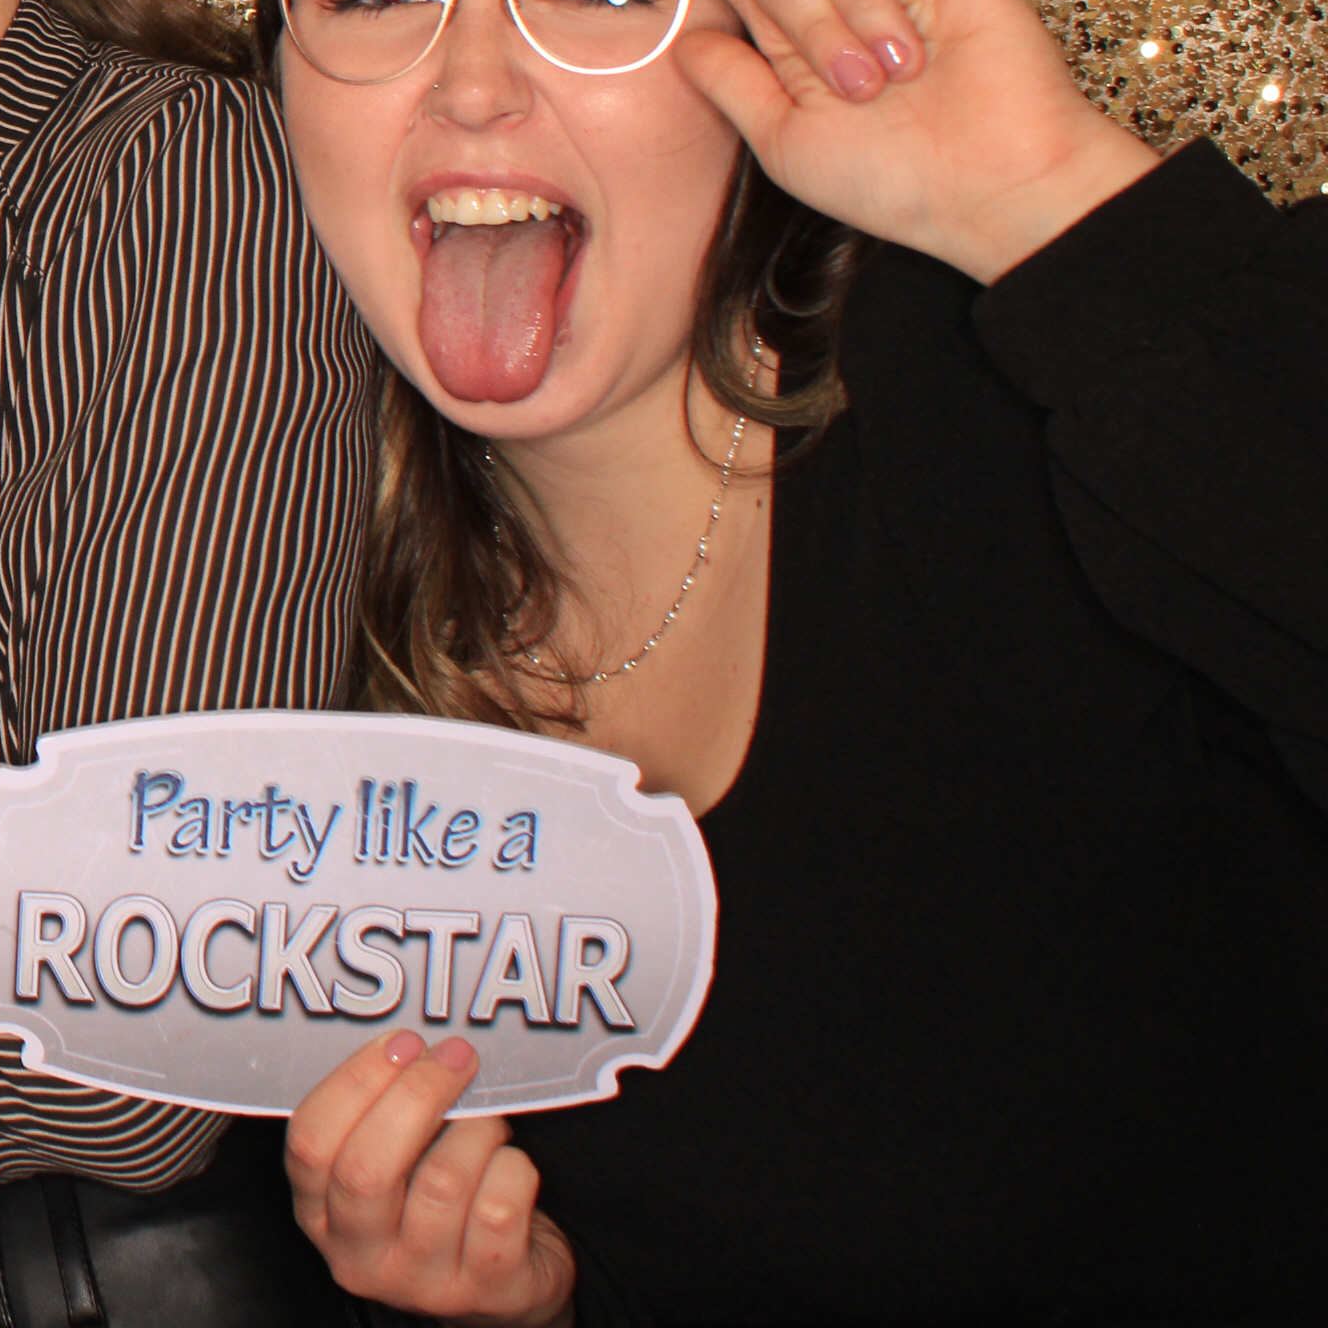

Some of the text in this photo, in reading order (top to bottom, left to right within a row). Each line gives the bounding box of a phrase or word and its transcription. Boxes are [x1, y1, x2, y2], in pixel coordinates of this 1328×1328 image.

[129, 769, 540, 881] Party like a
[15, 890, 636, 1028] ROCKSTAR
